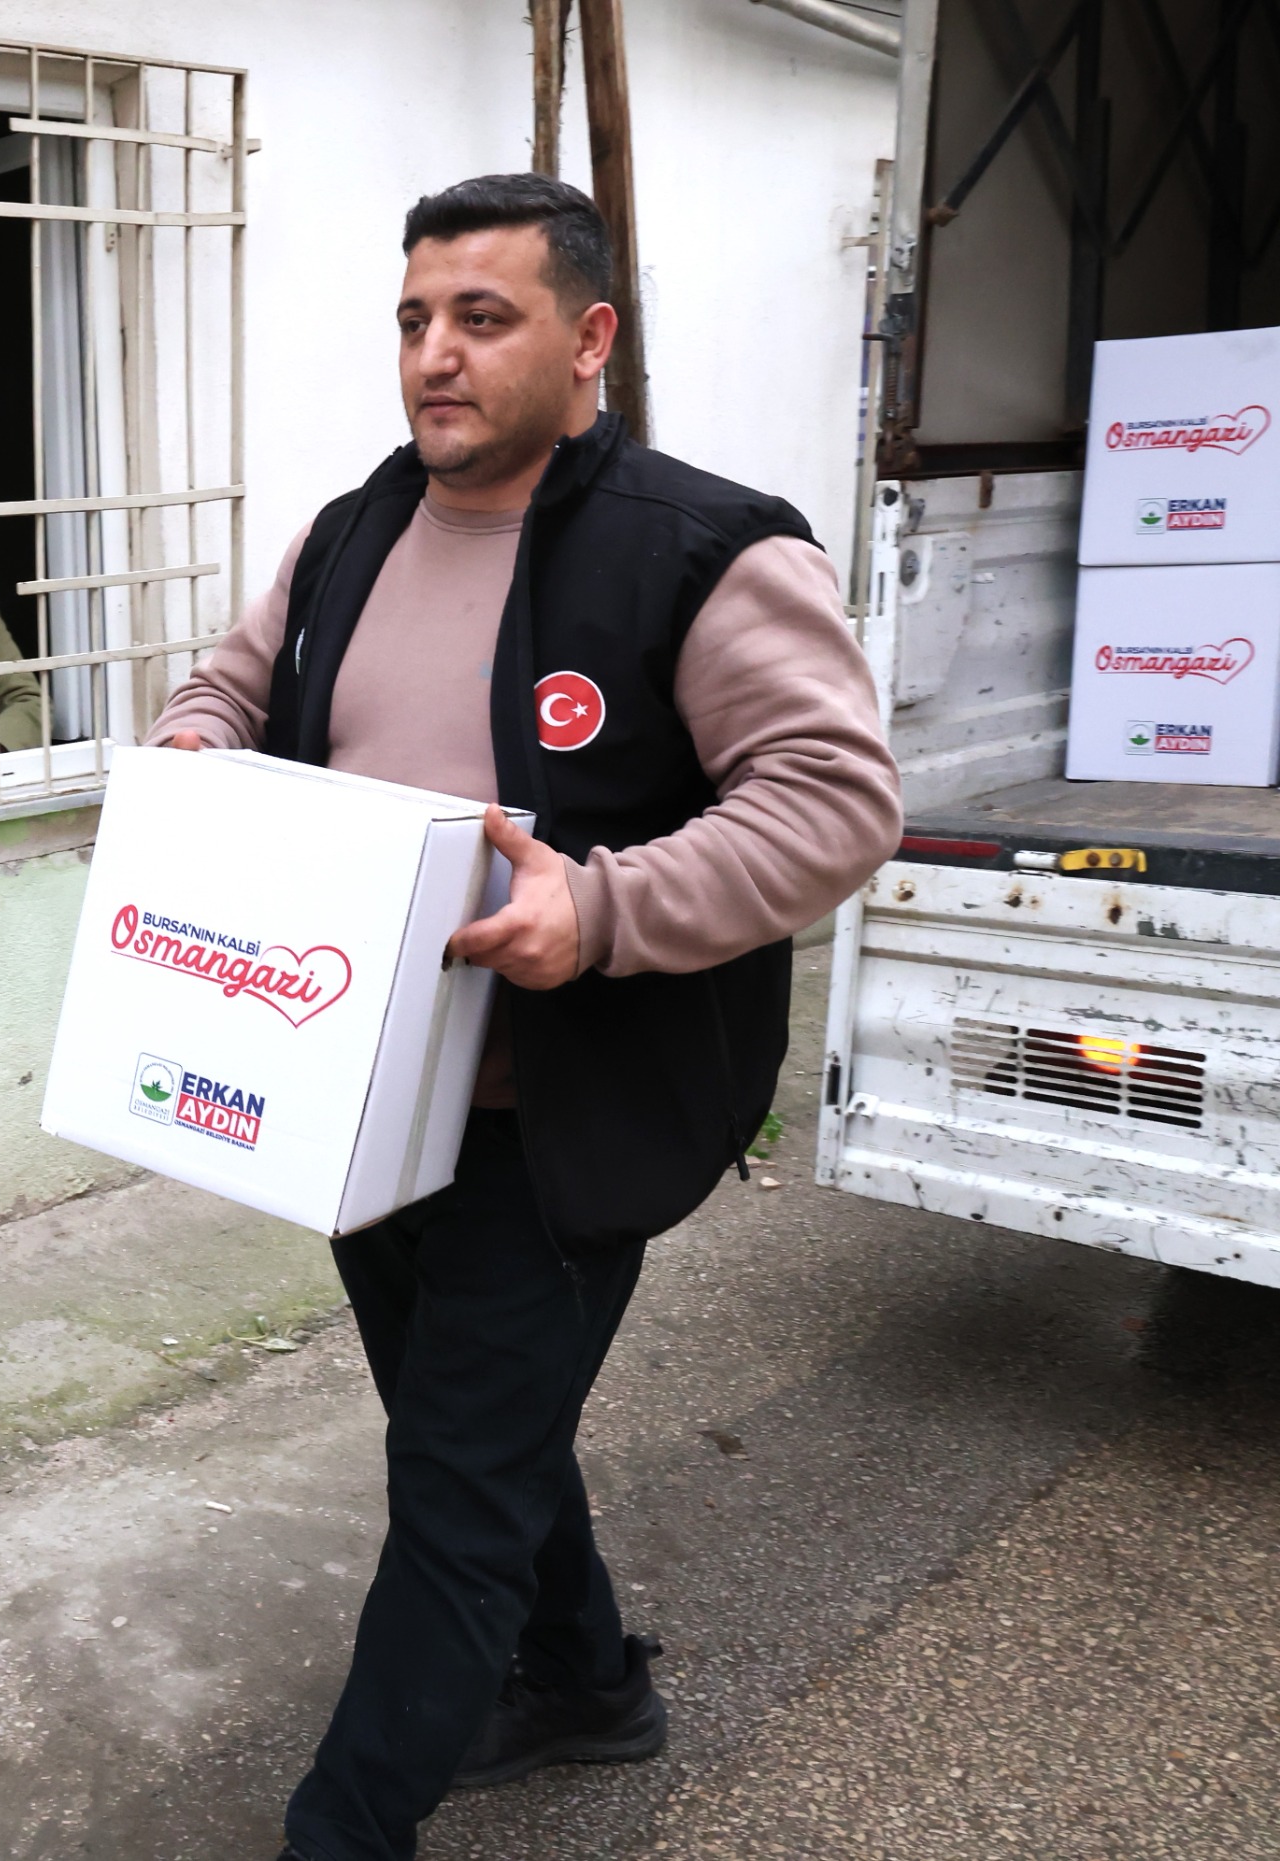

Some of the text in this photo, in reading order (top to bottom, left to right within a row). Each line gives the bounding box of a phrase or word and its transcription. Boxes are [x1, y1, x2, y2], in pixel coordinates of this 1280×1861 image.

[1106, 422, 1253, 452] Osmangazi
[1168, 498, 1226, 512] ERKAN
[1169, 514, 1222, 527] AYDIN
[1095, 645, 1237, 679] Osmangazi
[1155, 724, 1213, 736] ERKAN
[1157, 738, 1209, 750] AYDIN
[142, 912, 261, 957] BURSA'NIN KALBİ
[111, 904, 322, 1003] Osmangazi
[181, 1071, 266, 1118] ERKAN
[174, 1120, 206, 1134] OSMANGAZİ
[179, 1097, 257, 1141] AYDIN
